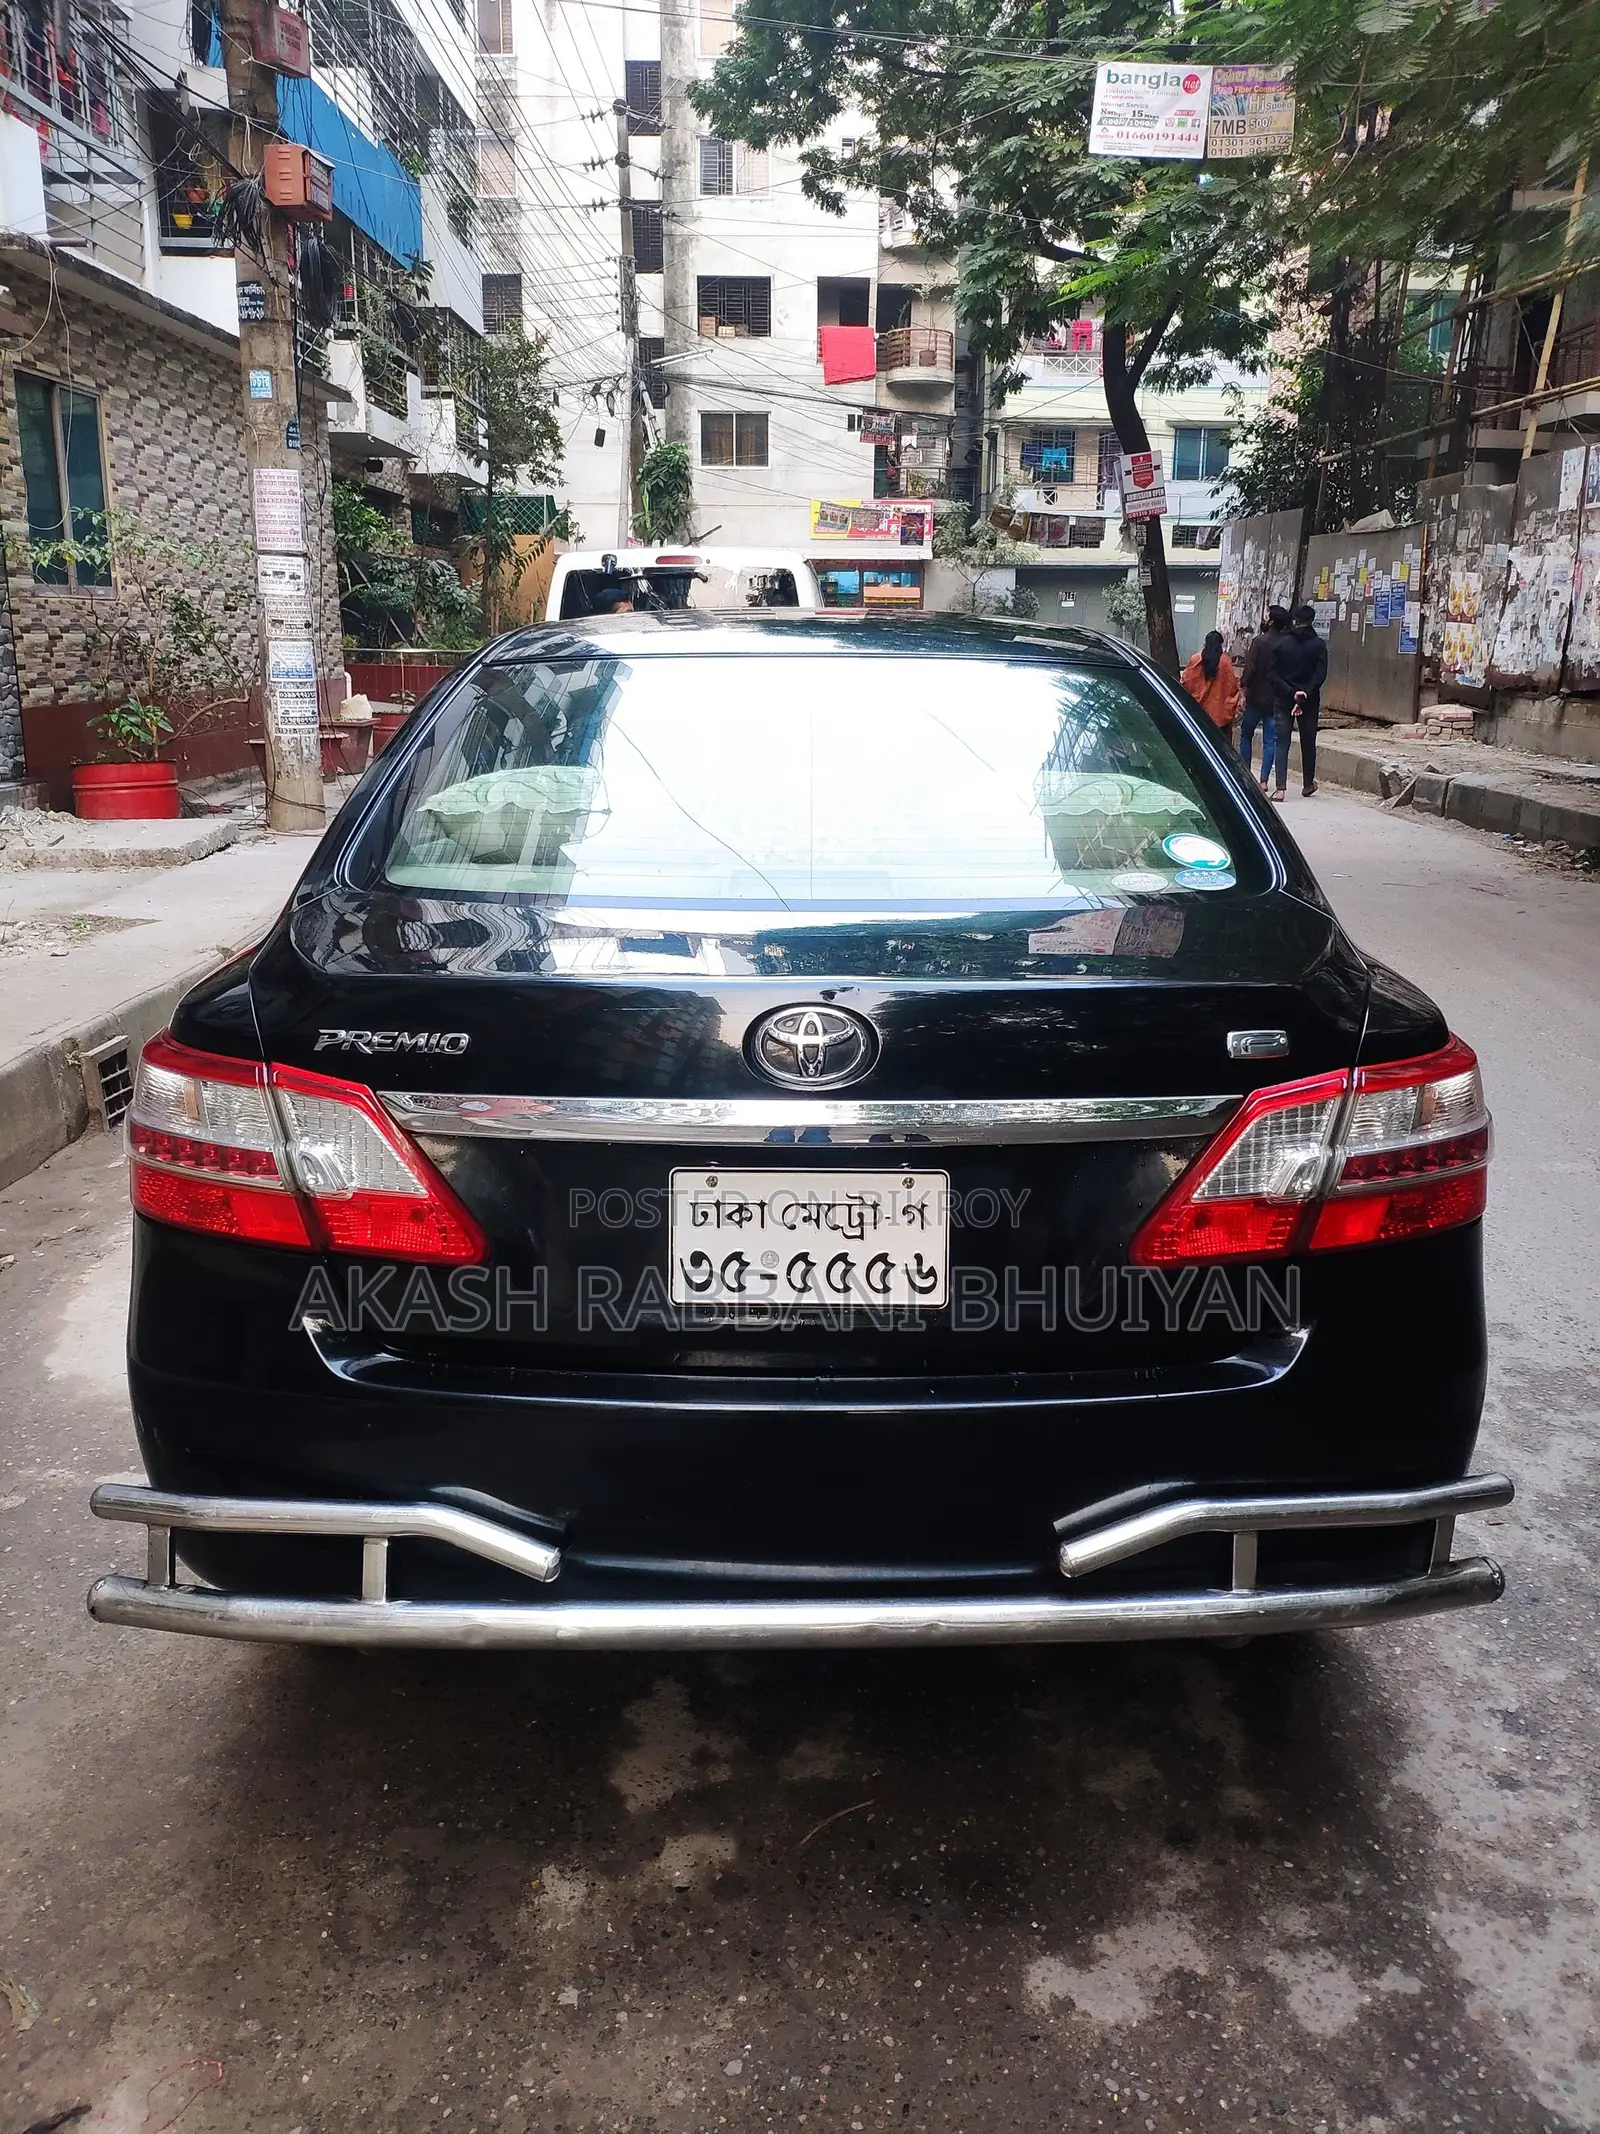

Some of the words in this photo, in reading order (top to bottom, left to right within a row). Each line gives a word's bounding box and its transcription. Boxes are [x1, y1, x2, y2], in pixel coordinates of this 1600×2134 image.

[1106, 69, 1181, 90] bangla
[1183, 78, 1201, 90] net
[1234, 85, 1253, 93] Fiber
[1126, 490, 1152, 502] ADMISSION
[1152, 488, 1165, 497] OPEN
[1066, 592, 1077, 600] LET
[313, 1029, 472, 1055] PREMIO
[688, 1197, 769, 1231] ঢাকা
[679, 1249, 939, 1296] ৩৫-৫৫৫৬
